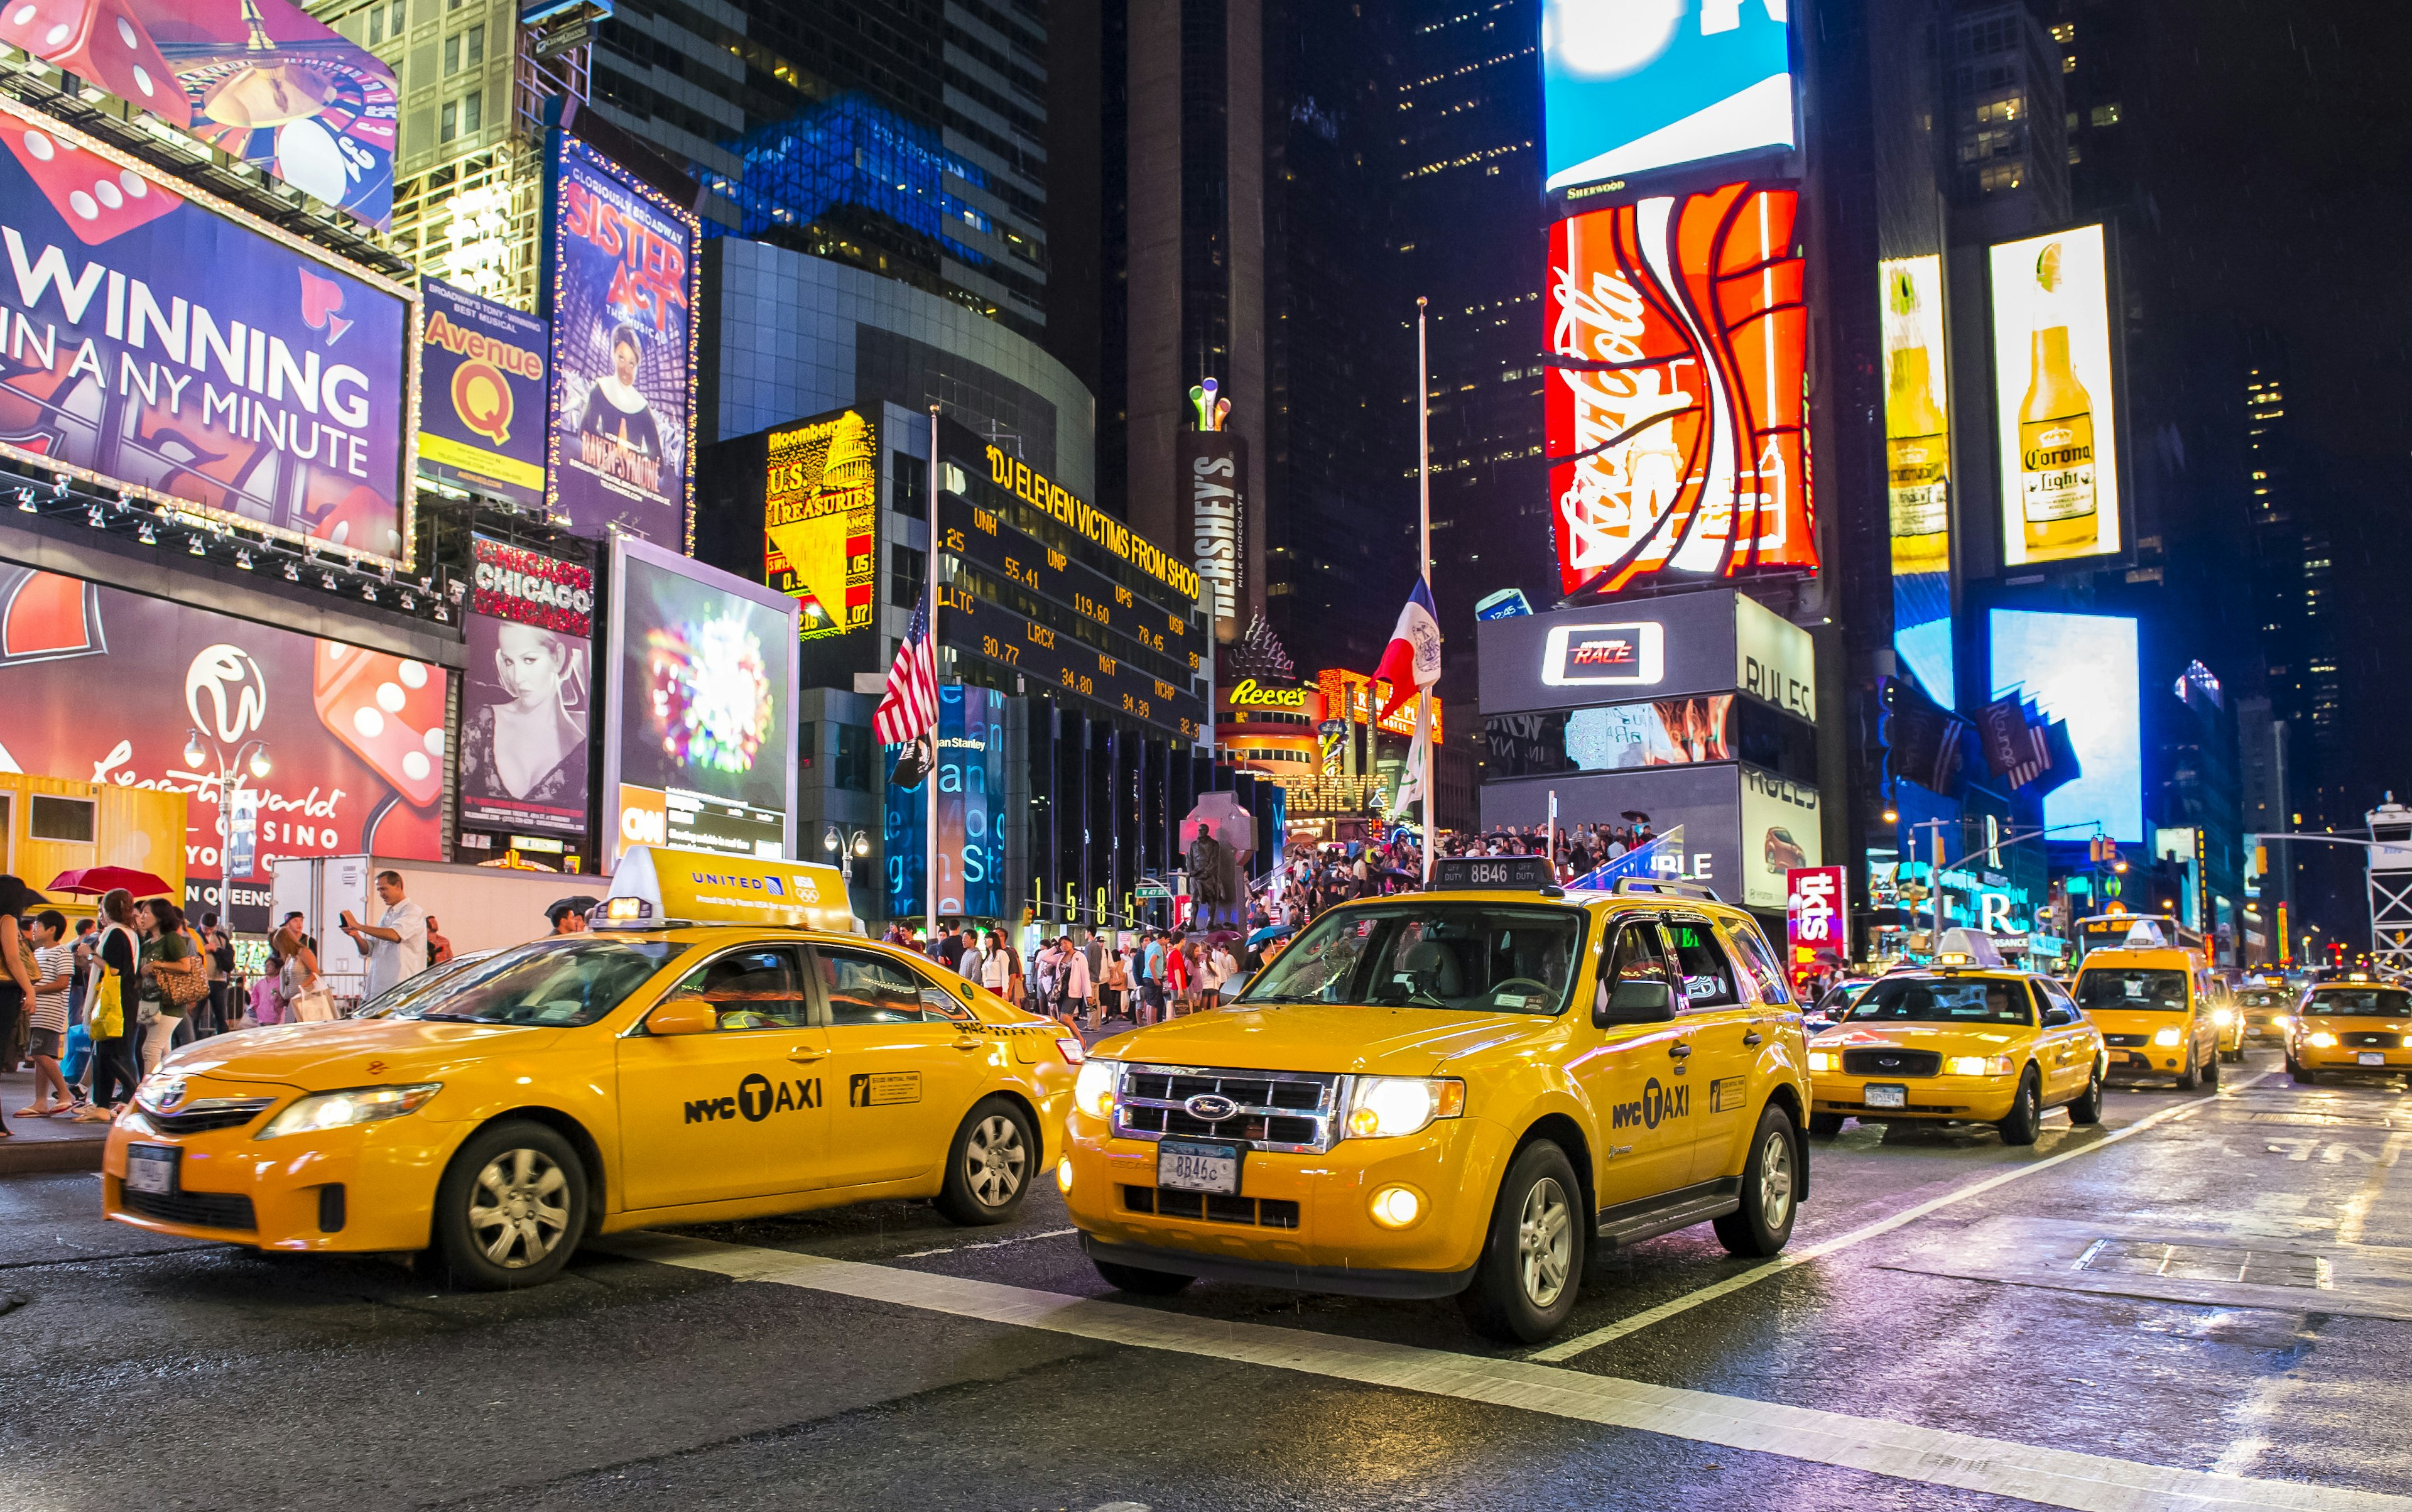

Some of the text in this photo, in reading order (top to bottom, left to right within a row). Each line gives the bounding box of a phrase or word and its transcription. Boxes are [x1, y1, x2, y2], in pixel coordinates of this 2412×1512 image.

[1567, 179, 1626, 200] SHERWOOD
[572, 168, 683, 245] GLORIOUSLY BROADWAY
[567, 182, 687, 309] SISTER
[429, 283, 481, 310] BROADWAY'S
[607, 259, 675, 332] ACT
[1, 225, 369, 428] WINNING
[454, 303, 517, 334] BEST MUSICAL
[606, 304, 624, 322] THE
[425, 311, 543, 379] Avenue
[0, 307, 55, 371] IN
[203, 382, 368, 477] MINUTE
[451, 360, 514, 447] Q
[768, 420, 842, 450] Bloomberg
[2025, 445, 2092, 472] Corona
[768, 462, 808, 494] U.S.
[2040, 471, 2078, 491] Light
[766, 486, 875, 526] TREASURIES
[847, 514, 874, 529] ANGE
[974, 507, 997, 537] UNH
[1015, 461, 1074, 527] ELEVEN
[1077, 499, 1129, 558] VICTIMS
[1131, 533, 1166, 582] FROM
[1167, 555, 1200, 599] SHOO
[847, 553, 869, 574] .05
[1004, 556, 1038, 590] 55.41
[1047, 547, 1067, 573] UNP
[474, 563, 590, 614] CHICAGO
[937, 585, 974, 615] LLTC
[1115, 584, 1133, 609] UPS
[847, 604, 868, 624] .07
[1074, 592, 1110, 626] 119.60
[1491, 606, 1516, 619] 12:45
[1027, 621, 1055, 650] LRCX
[1138, 624, 1165, 652] 78.45
[1168, 614, 1185, 636] USB
[982, 634, 1019, 666] 30.77
[1573, 646, 1632, 664] RACE
[1098, 653, 1116, 677] MAT
[1061, 667, 1093, 697] 34.80
[1154, 678, 1175, 702] MCHP
[1229, 679, 1308, 707] Reese's
[1122, 693, 1150, 719] 34.39
[1383, 719, 1406, 731] HOTEL
[952, 737, 986, 752] Stanley
[1254, 774, 1389, 812] RSHEY'S
[215, 817, 339, 849] CSINO
[692, 872, 763, 889] UNITED
[1445, 873, 1462, 881] DUTY
[1471, 864, 1507, 883] 8B46
[1516, 872, 1535, 880] DUTY
[1800, 873, 1835, 940] tkts
[1980, 893, 2026, 935] R
[1992, 938, 2028, 947] SSANCE
[684, 1077, 823, 1124] NYC TAXI
[1612, 1101, 1642, 1129] NYC
[1647, 1084, 1689, 1123] TAXI
